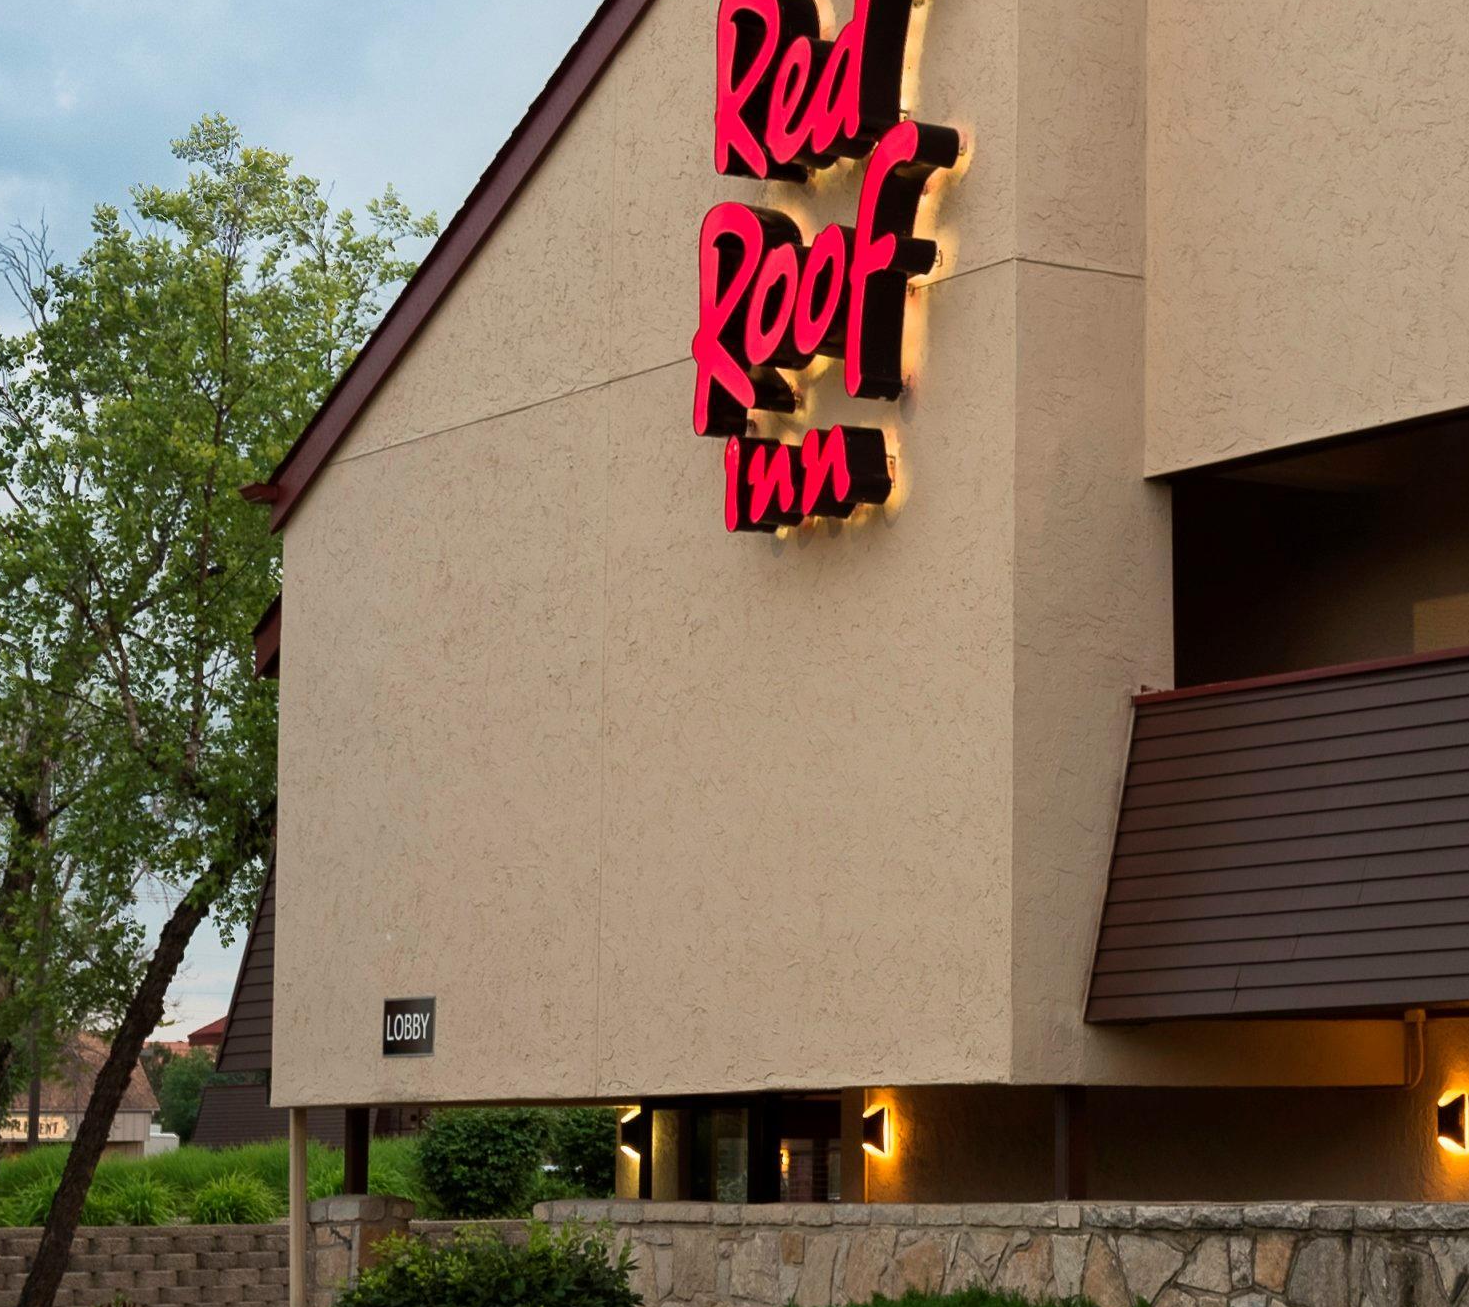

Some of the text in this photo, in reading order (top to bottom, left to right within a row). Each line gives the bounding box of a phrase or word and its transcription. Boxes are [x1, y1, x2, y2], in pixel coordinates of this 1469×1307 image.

[691, 120, 919, 436] Roof
[724, 423, 851, 533] Inn
[386, 1012, 430, 1041] LOBBY
